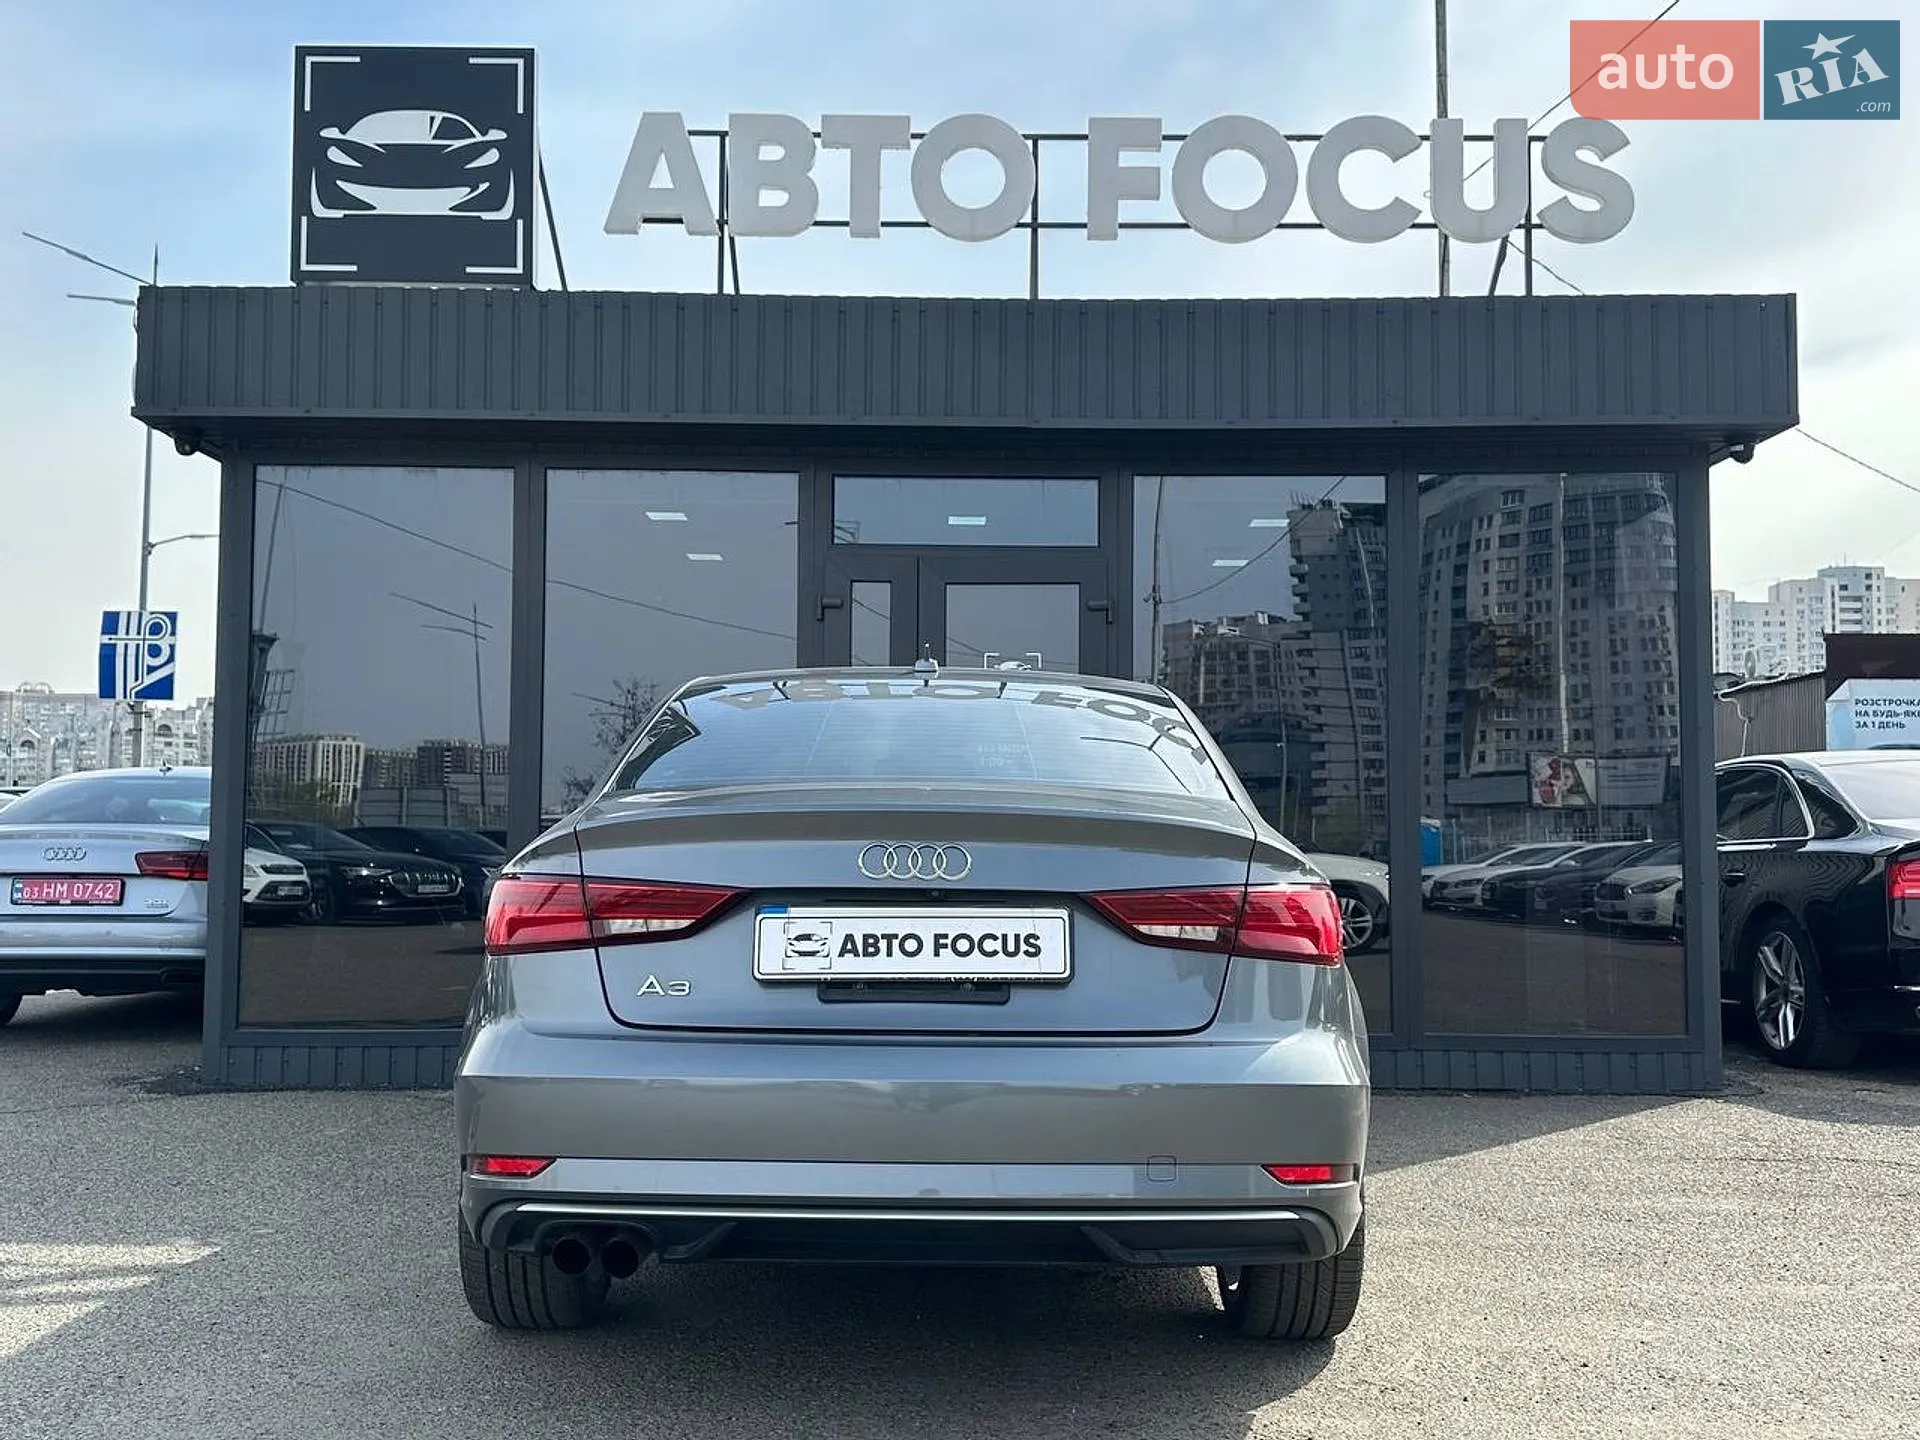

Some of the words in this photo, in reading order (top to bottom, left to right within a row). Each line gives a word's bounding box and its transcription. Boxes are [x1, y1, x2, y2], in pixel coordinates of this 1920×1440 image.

[603, 112, 1036, 243] АВТО
[1085, 115, 1636, 244] FOCUS
[1855, 721, 1868, 729] ЗА
[1871, 721, 1875, 729] 1
[1878, 721, 1905, 729] ДЕНЬ
[42, 883, 67, 899] HM
[73, 883, 115, 898] 0742
[837, 933, 924, 958] АВТО
[933, 933, 1042, 958] FOCUS
[636, 974, 690, 996] A3
